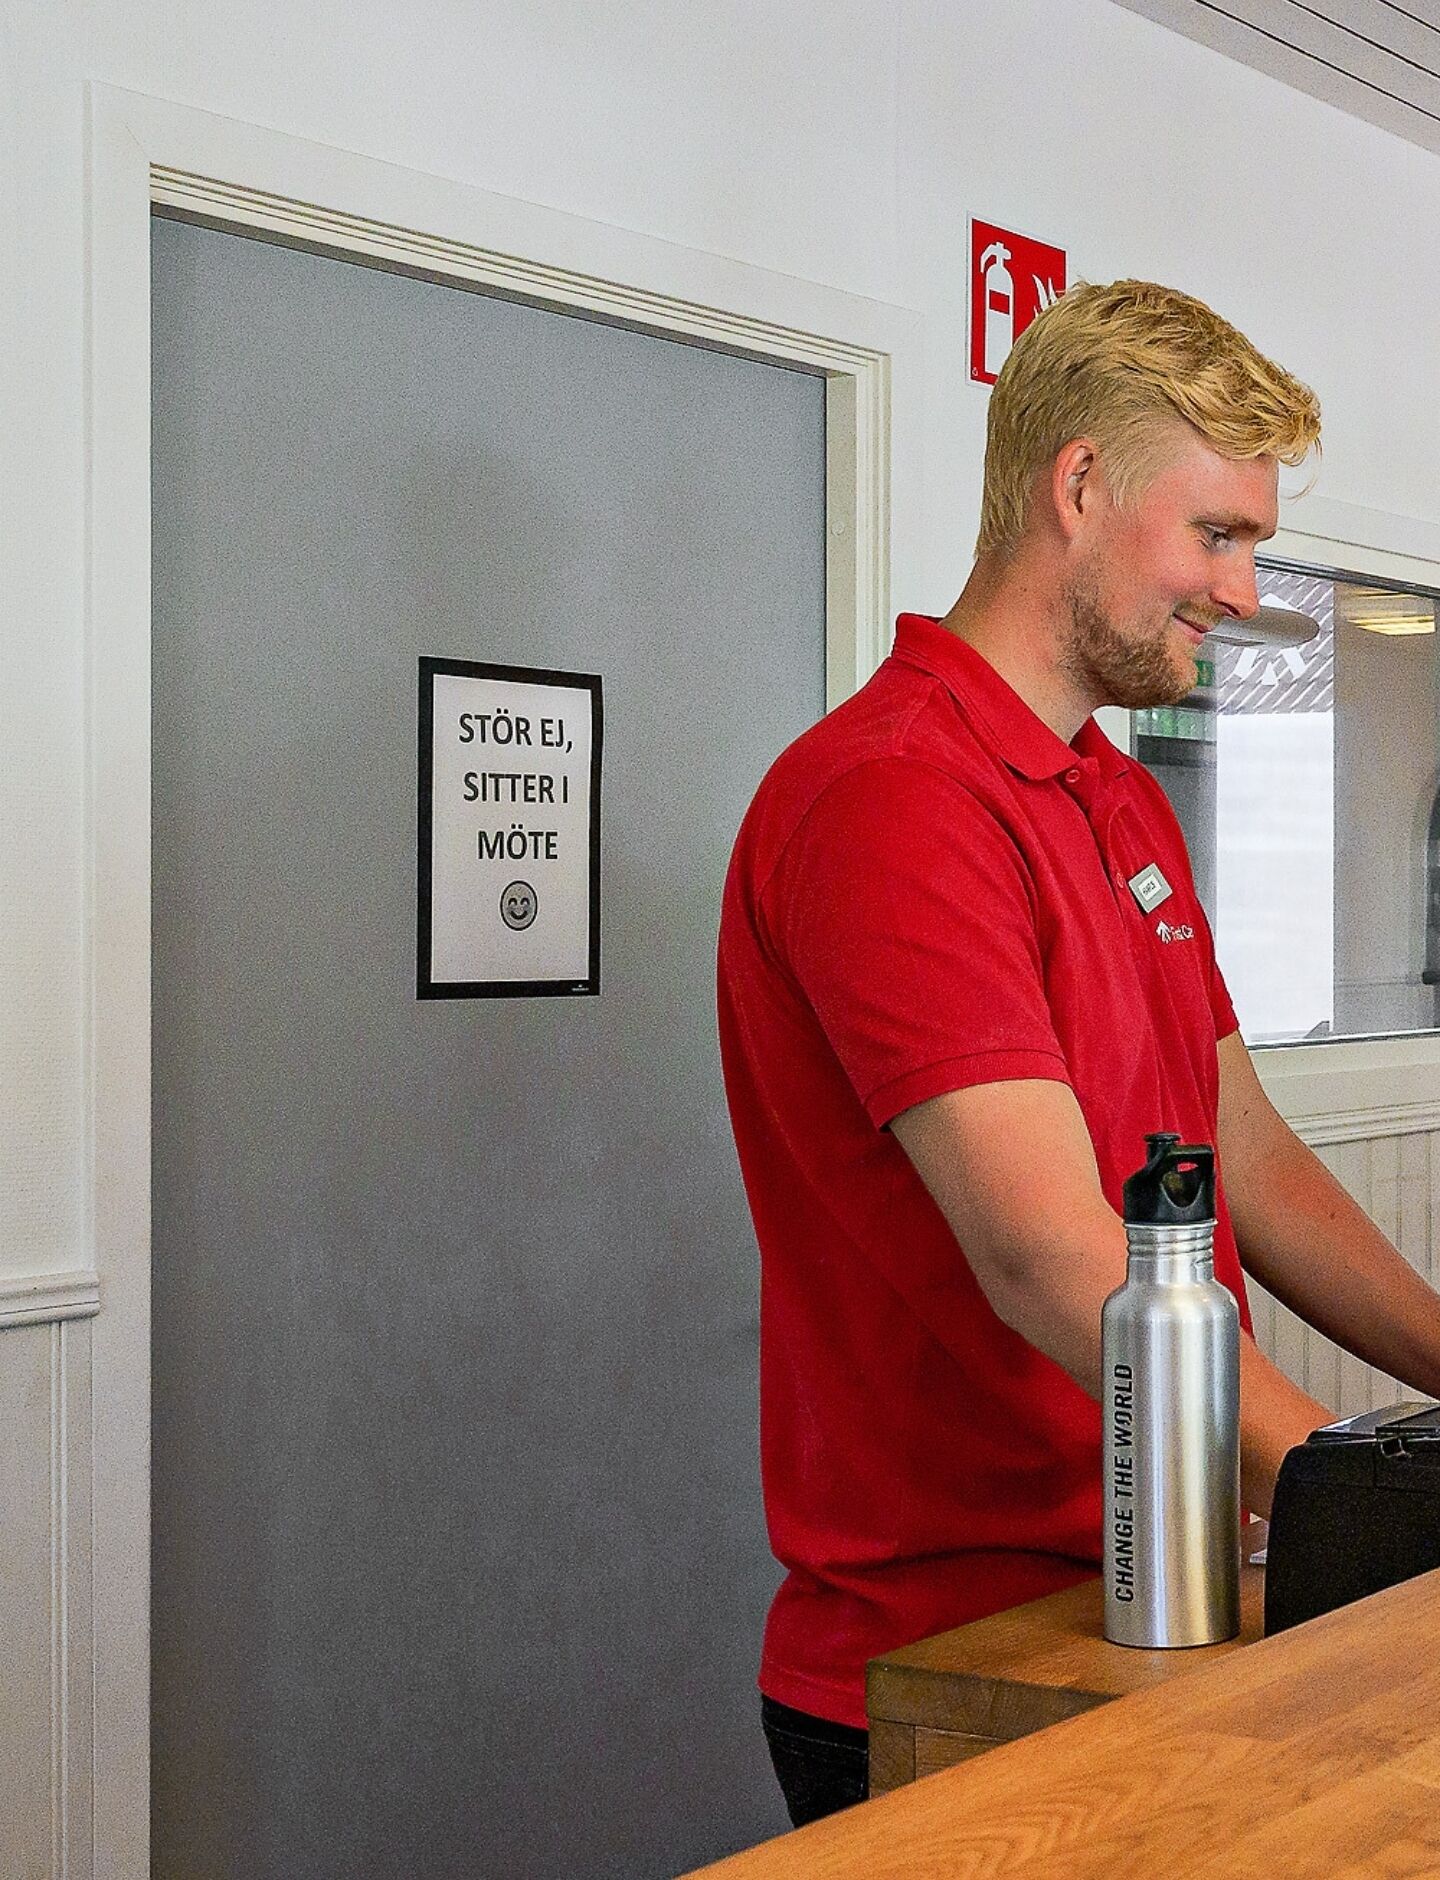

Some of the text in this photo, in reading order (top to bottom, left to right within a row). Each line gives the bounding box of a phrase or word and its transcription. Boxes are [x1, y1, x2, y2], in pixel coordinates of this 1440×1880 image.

[458, 708, 573, 753] STÖR EJ,
[463, 772, 568, 803] SITTER I
[478, 824, 558, 860] MÖTE
[1114, 1363, 1134, 1602] CHANGE THE WORLD
